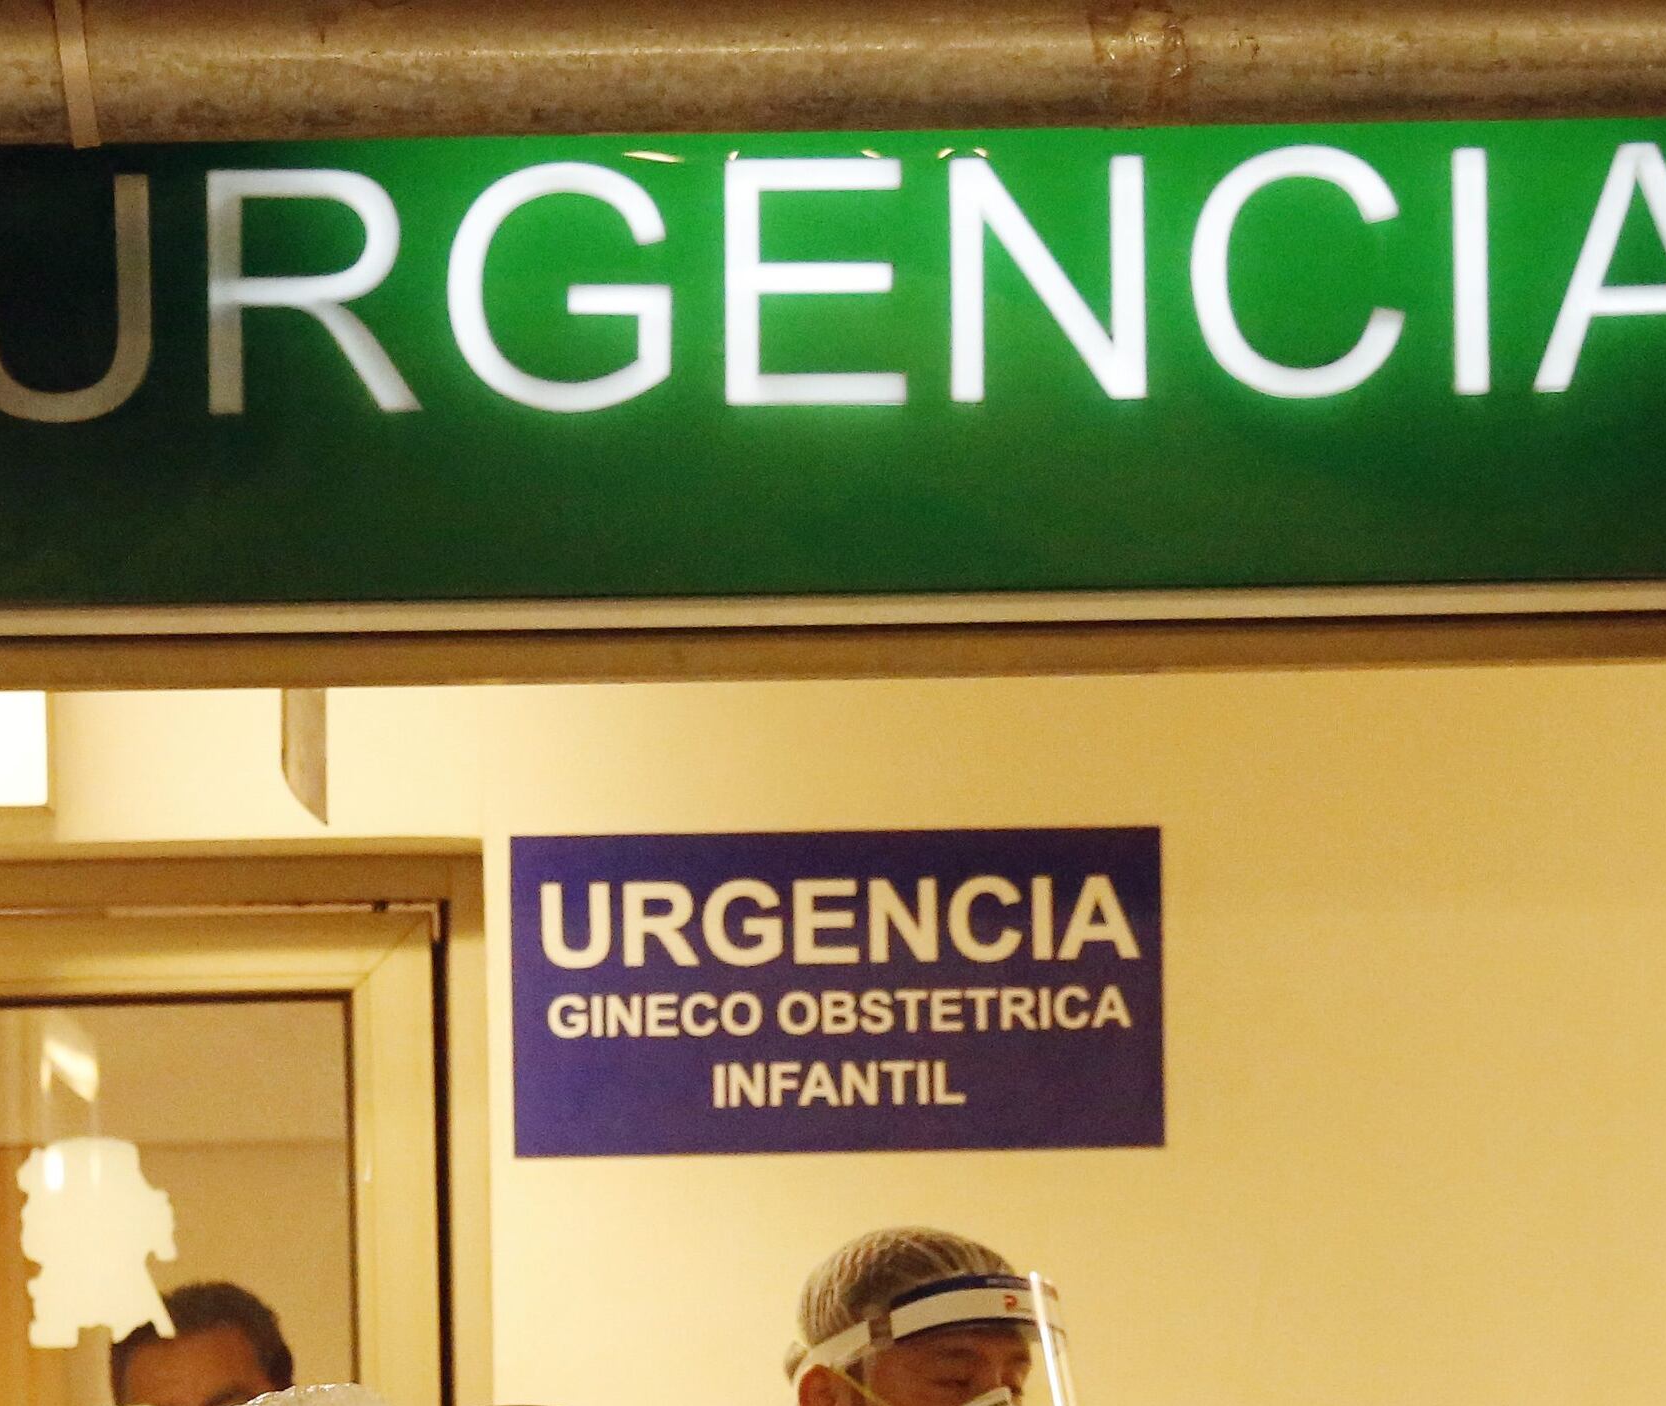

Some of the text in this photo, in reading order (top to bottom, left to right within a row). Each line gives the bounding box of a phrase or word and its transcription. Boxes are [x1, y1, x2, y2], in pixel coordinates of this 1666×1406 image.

[539, 874, 1142, 970] URGENCIA
[546, 985, 1132, 1039] GINECO OBSTETRICA
[712, 1060, 967, 1109] INFANTIL
